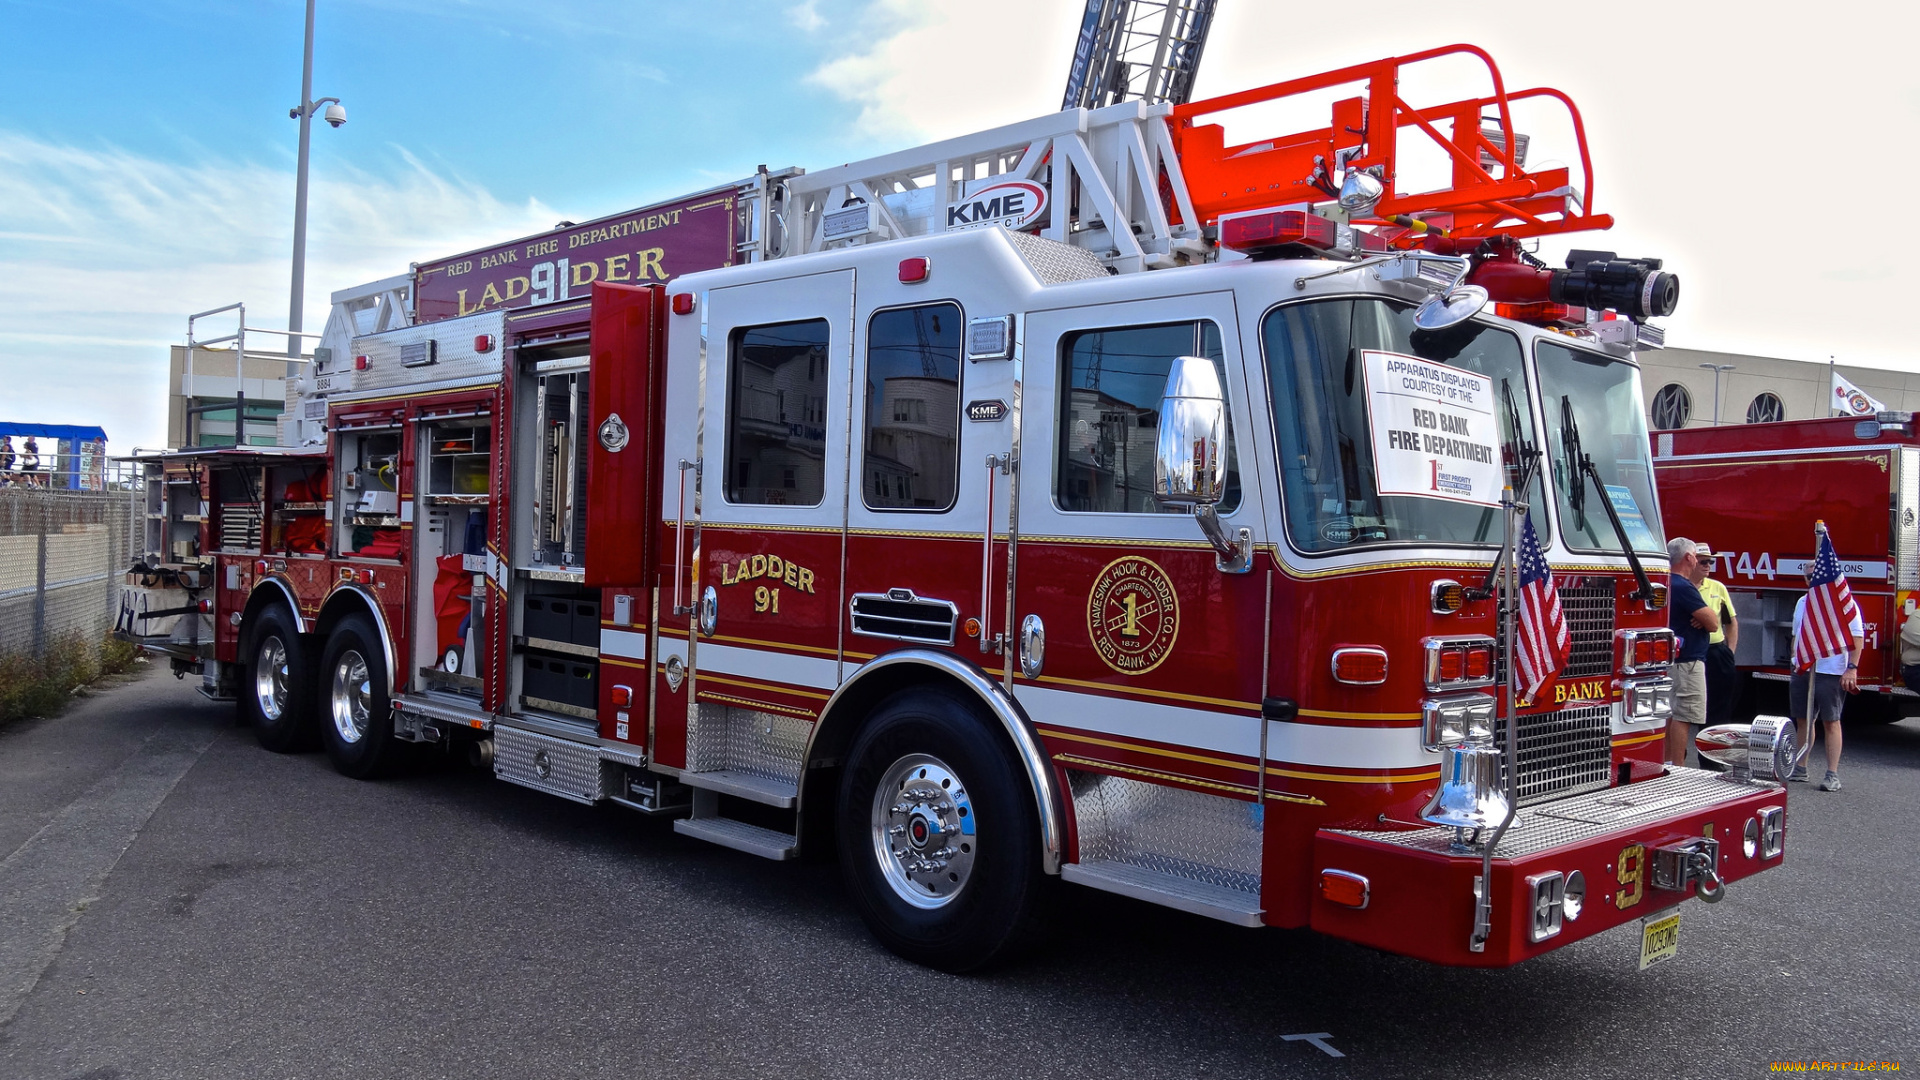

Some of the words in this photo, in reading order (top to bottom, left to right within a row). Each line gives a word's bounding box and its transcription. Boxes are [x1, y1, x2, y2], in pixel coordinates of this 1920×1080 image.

[948, 192, 1025, 226] KME
[447, 262, 473, 277] RED
[481, 249, 518, 270] BANK
[526, 239, 559, 259] FIRE
[569, 209, 683, 250] DEPARTMENT
[317, 378, 331, 390] 8884
[1387, 360, 1440, 382] APPARATUS
[1441, 371, 1480, 392] DISPLAYED
[1402, 377, 1446, 398] COURTESY
[1448, 387, 1459, 399] OF
[1459, 390, 1473, 403] THE
[971, 406, 998, 415] KME
[1413, 408, 1437, 430] RED
[1440, 412, 1470, 437] BANK
[1388, 430, 1421, 451] FIRE
[1423, 434, 1492, 465] DEPARTMENT
[1326, 530, 1352, 538] KME
[721, 554, 815, 594] LADDER
[754, 586, 780, 613] 91
[1092, 574, 1113, 628] NAVESINK
[1112, 562, 1138, 579] HOOK
[1140, 566, 1148, 577] &
[1148, 570, 1174, 612] LADDER
[1161, 616, 1174, 634] CO.
[1115, 582, 1152, 599] CHARTERED
[1122, 592, 1140, 636] 1
[1098, 636, 1116, 659] RED
[1121, 640, 1140, 648] 1873
[1554, 681, 1606, 703] BANK
[1644, 924, 1678, 956] 10293MG
